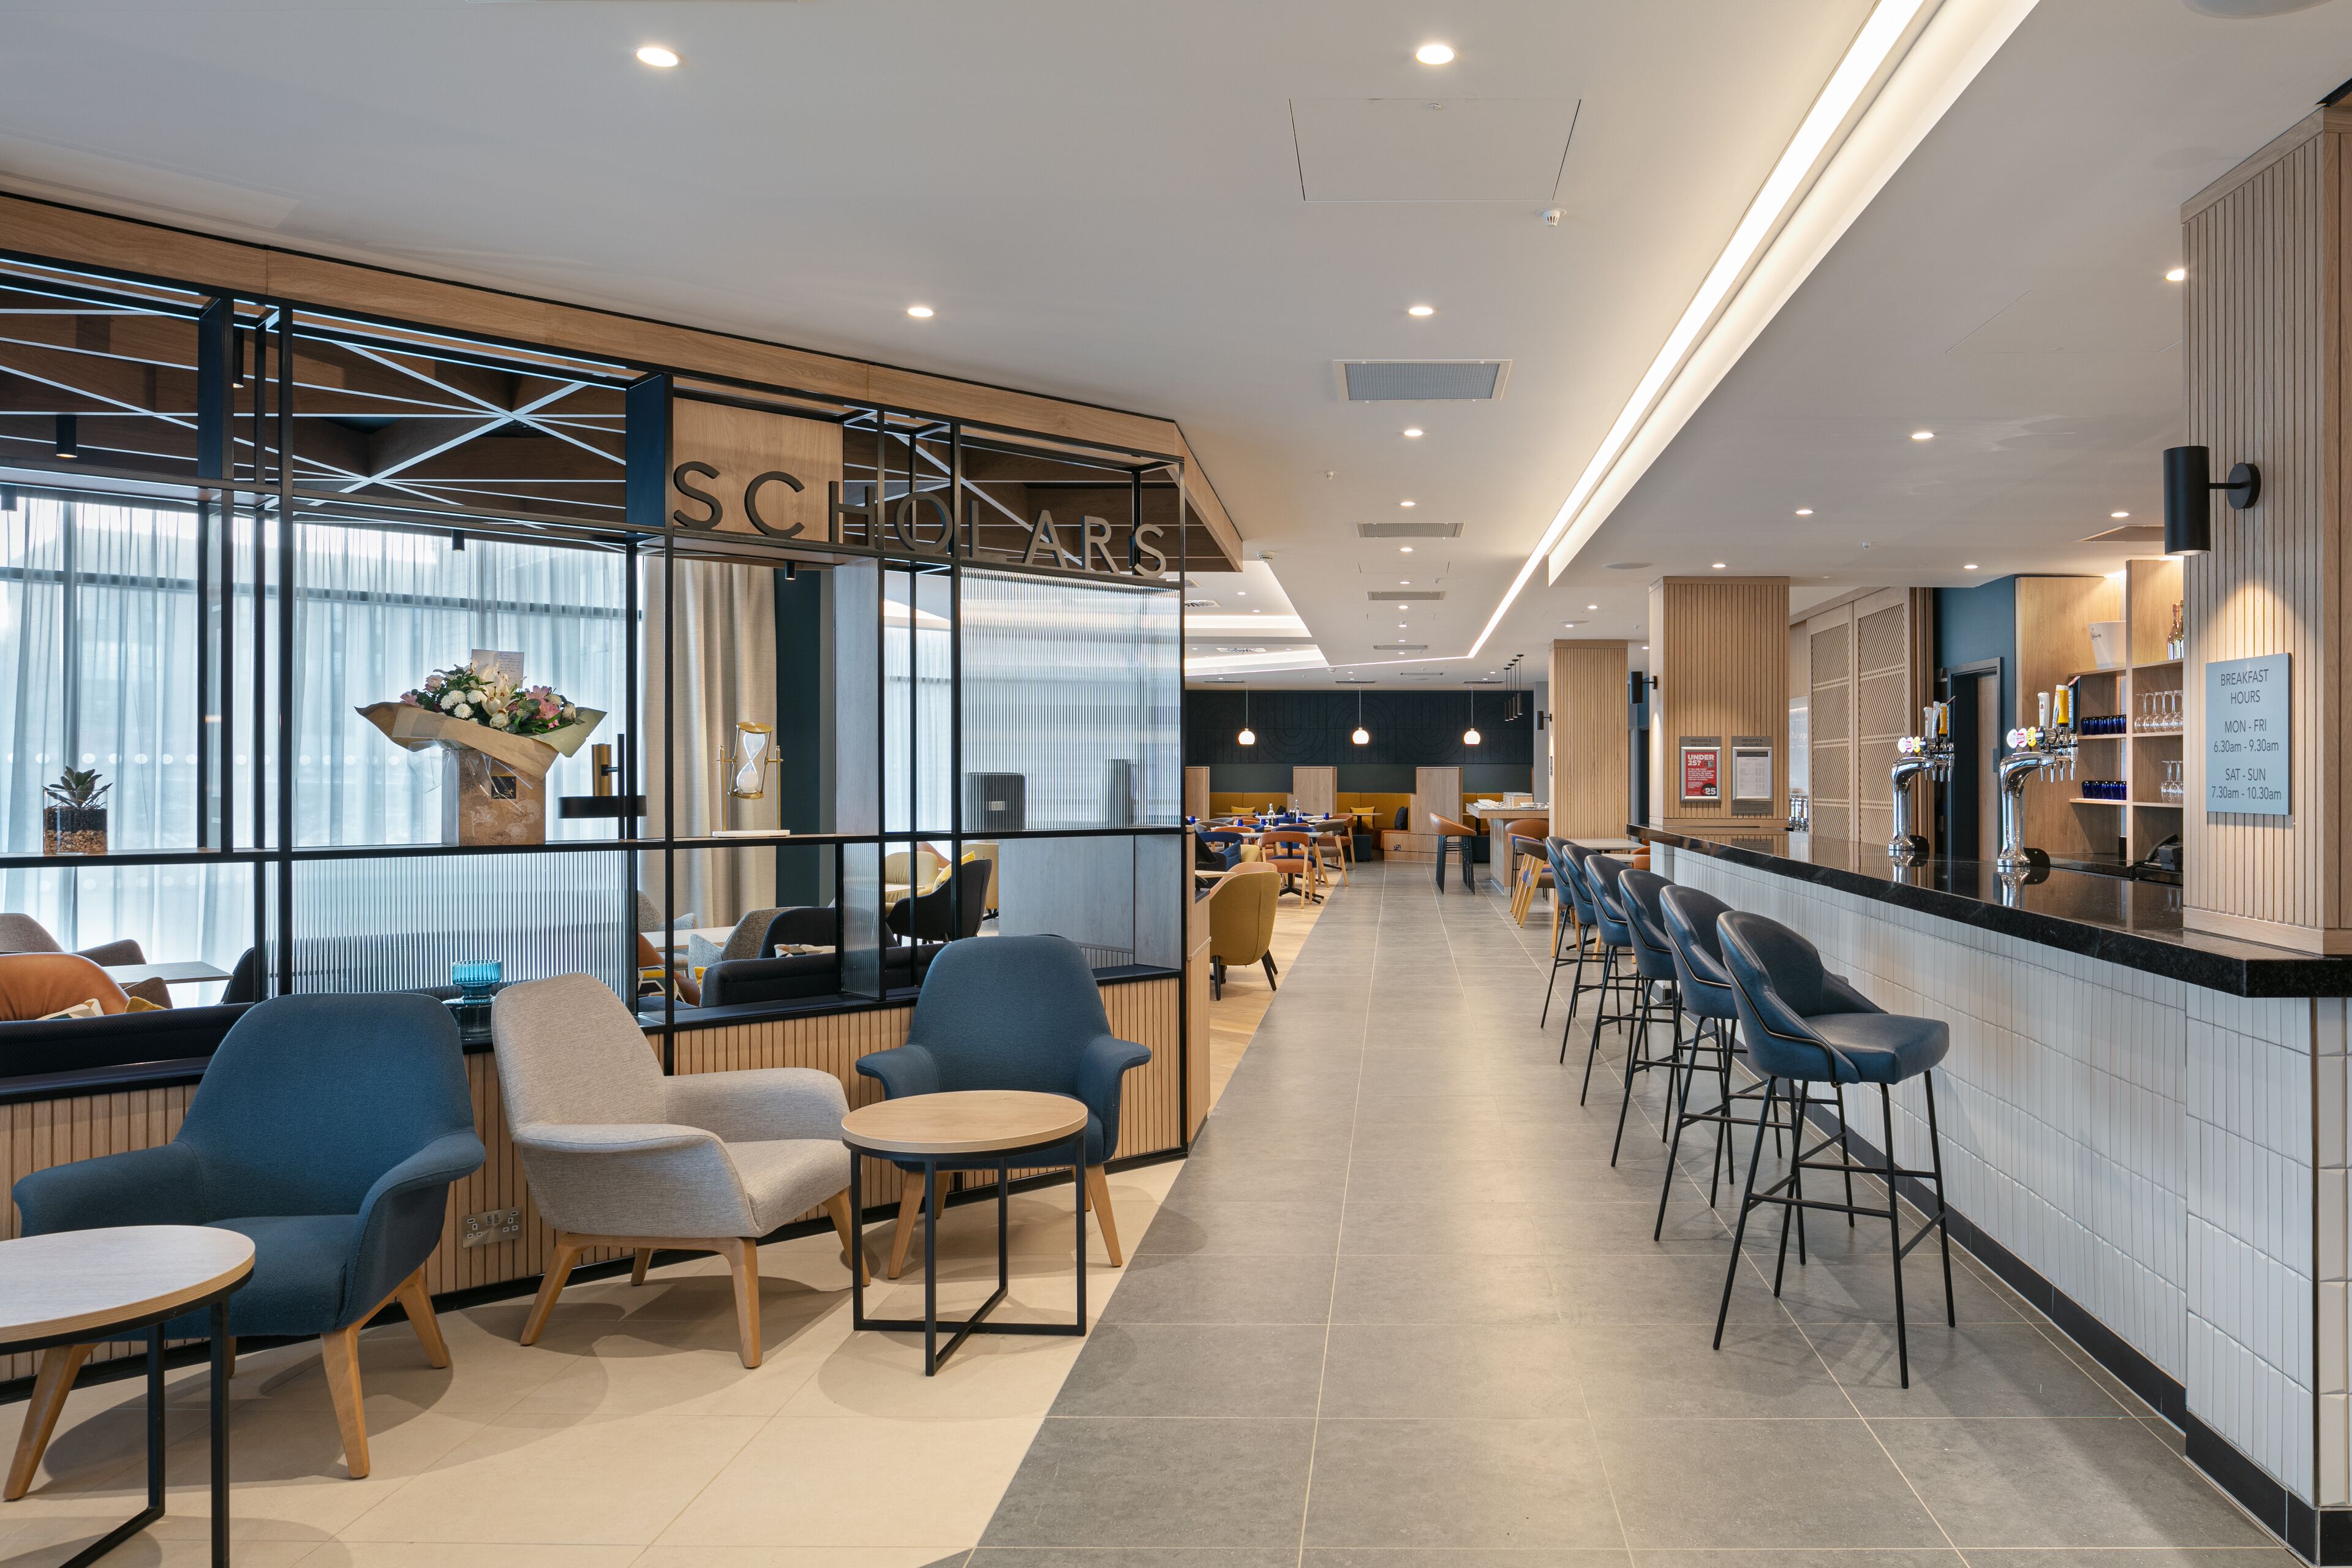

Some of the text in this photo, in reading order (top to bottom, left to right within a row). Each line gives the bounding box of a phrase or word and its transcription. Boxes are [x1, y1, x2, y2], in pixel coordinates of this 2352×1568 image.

[673, 461, 1166, 578] SCHOLARS
[2220, 669, 2269, 686] BREAKFAST
[2231, 690, 2260, 704] HOURS
[2225, 720, 2246, 733] MON
[2254, 718, 2267, 732] FRI
[2214, 740, 2242, 753] 6.30am
[2248, 739, 2279, 752] 9.30am
[2225, 768, 2241, 781] SAT
[2247, 768, 2266, 781] SUN
[2211, 786, 2239, 799] 7.30am
[2247, 786, 2282, 800] 10.30am
